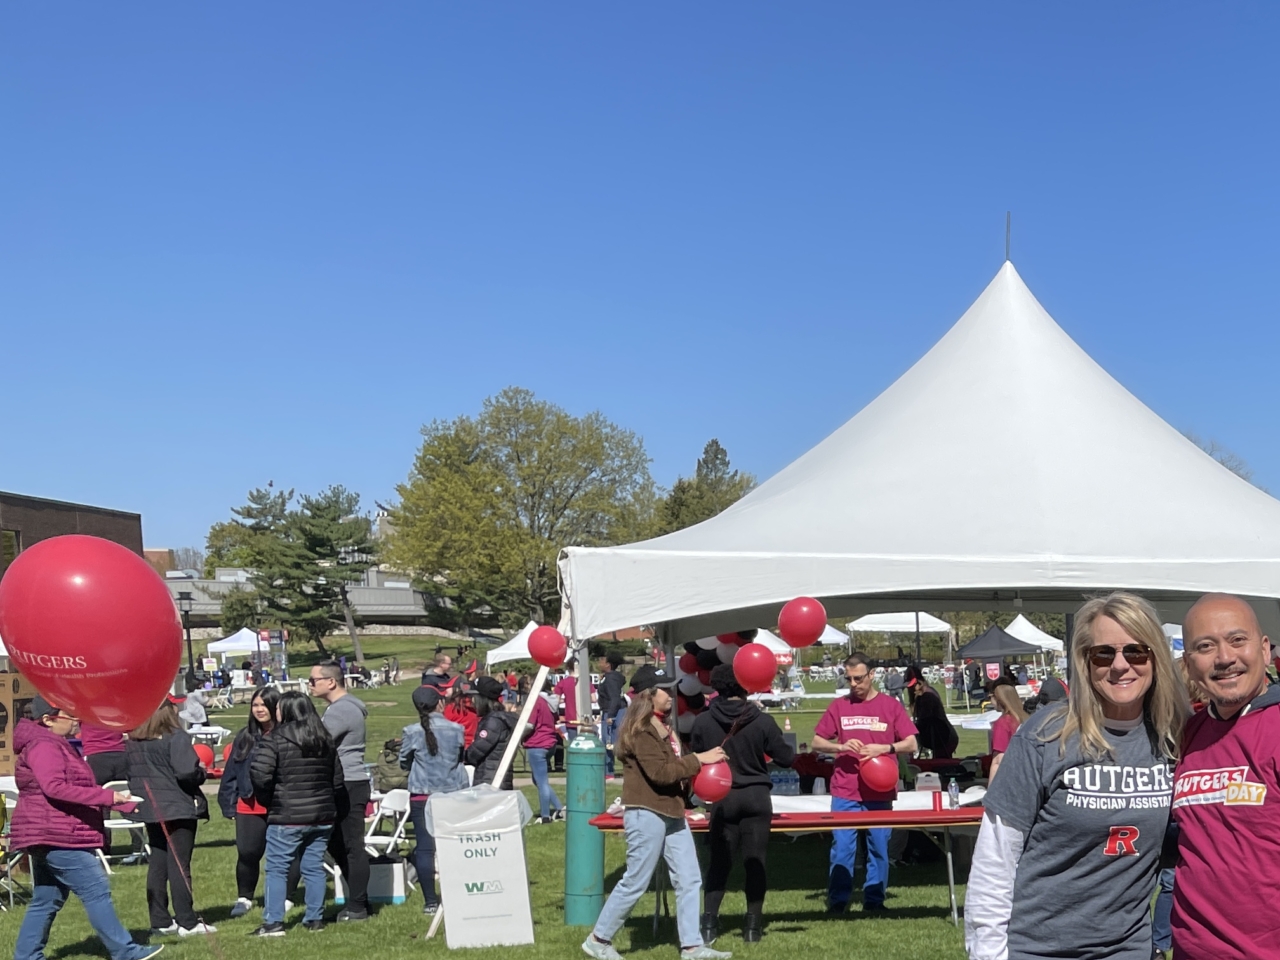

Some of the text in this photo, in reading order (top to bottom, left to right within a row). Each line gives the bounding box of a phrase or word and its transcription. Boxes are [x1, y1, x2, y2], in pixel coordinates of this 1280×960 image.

[8, 643, 88, 670] RUTGERS
[1174, 771, 1243, 796] RUTGERS
[1227, 785, 1263, 802] DAY
[1066, 794, 1126, 810] PHYSICIAN
[458, 832, 501, 844] TRASH
[1103, 826, 1140, 857] R
[464, 847, 498, 859] ONLY
[465, 880, 504, 893] WM
